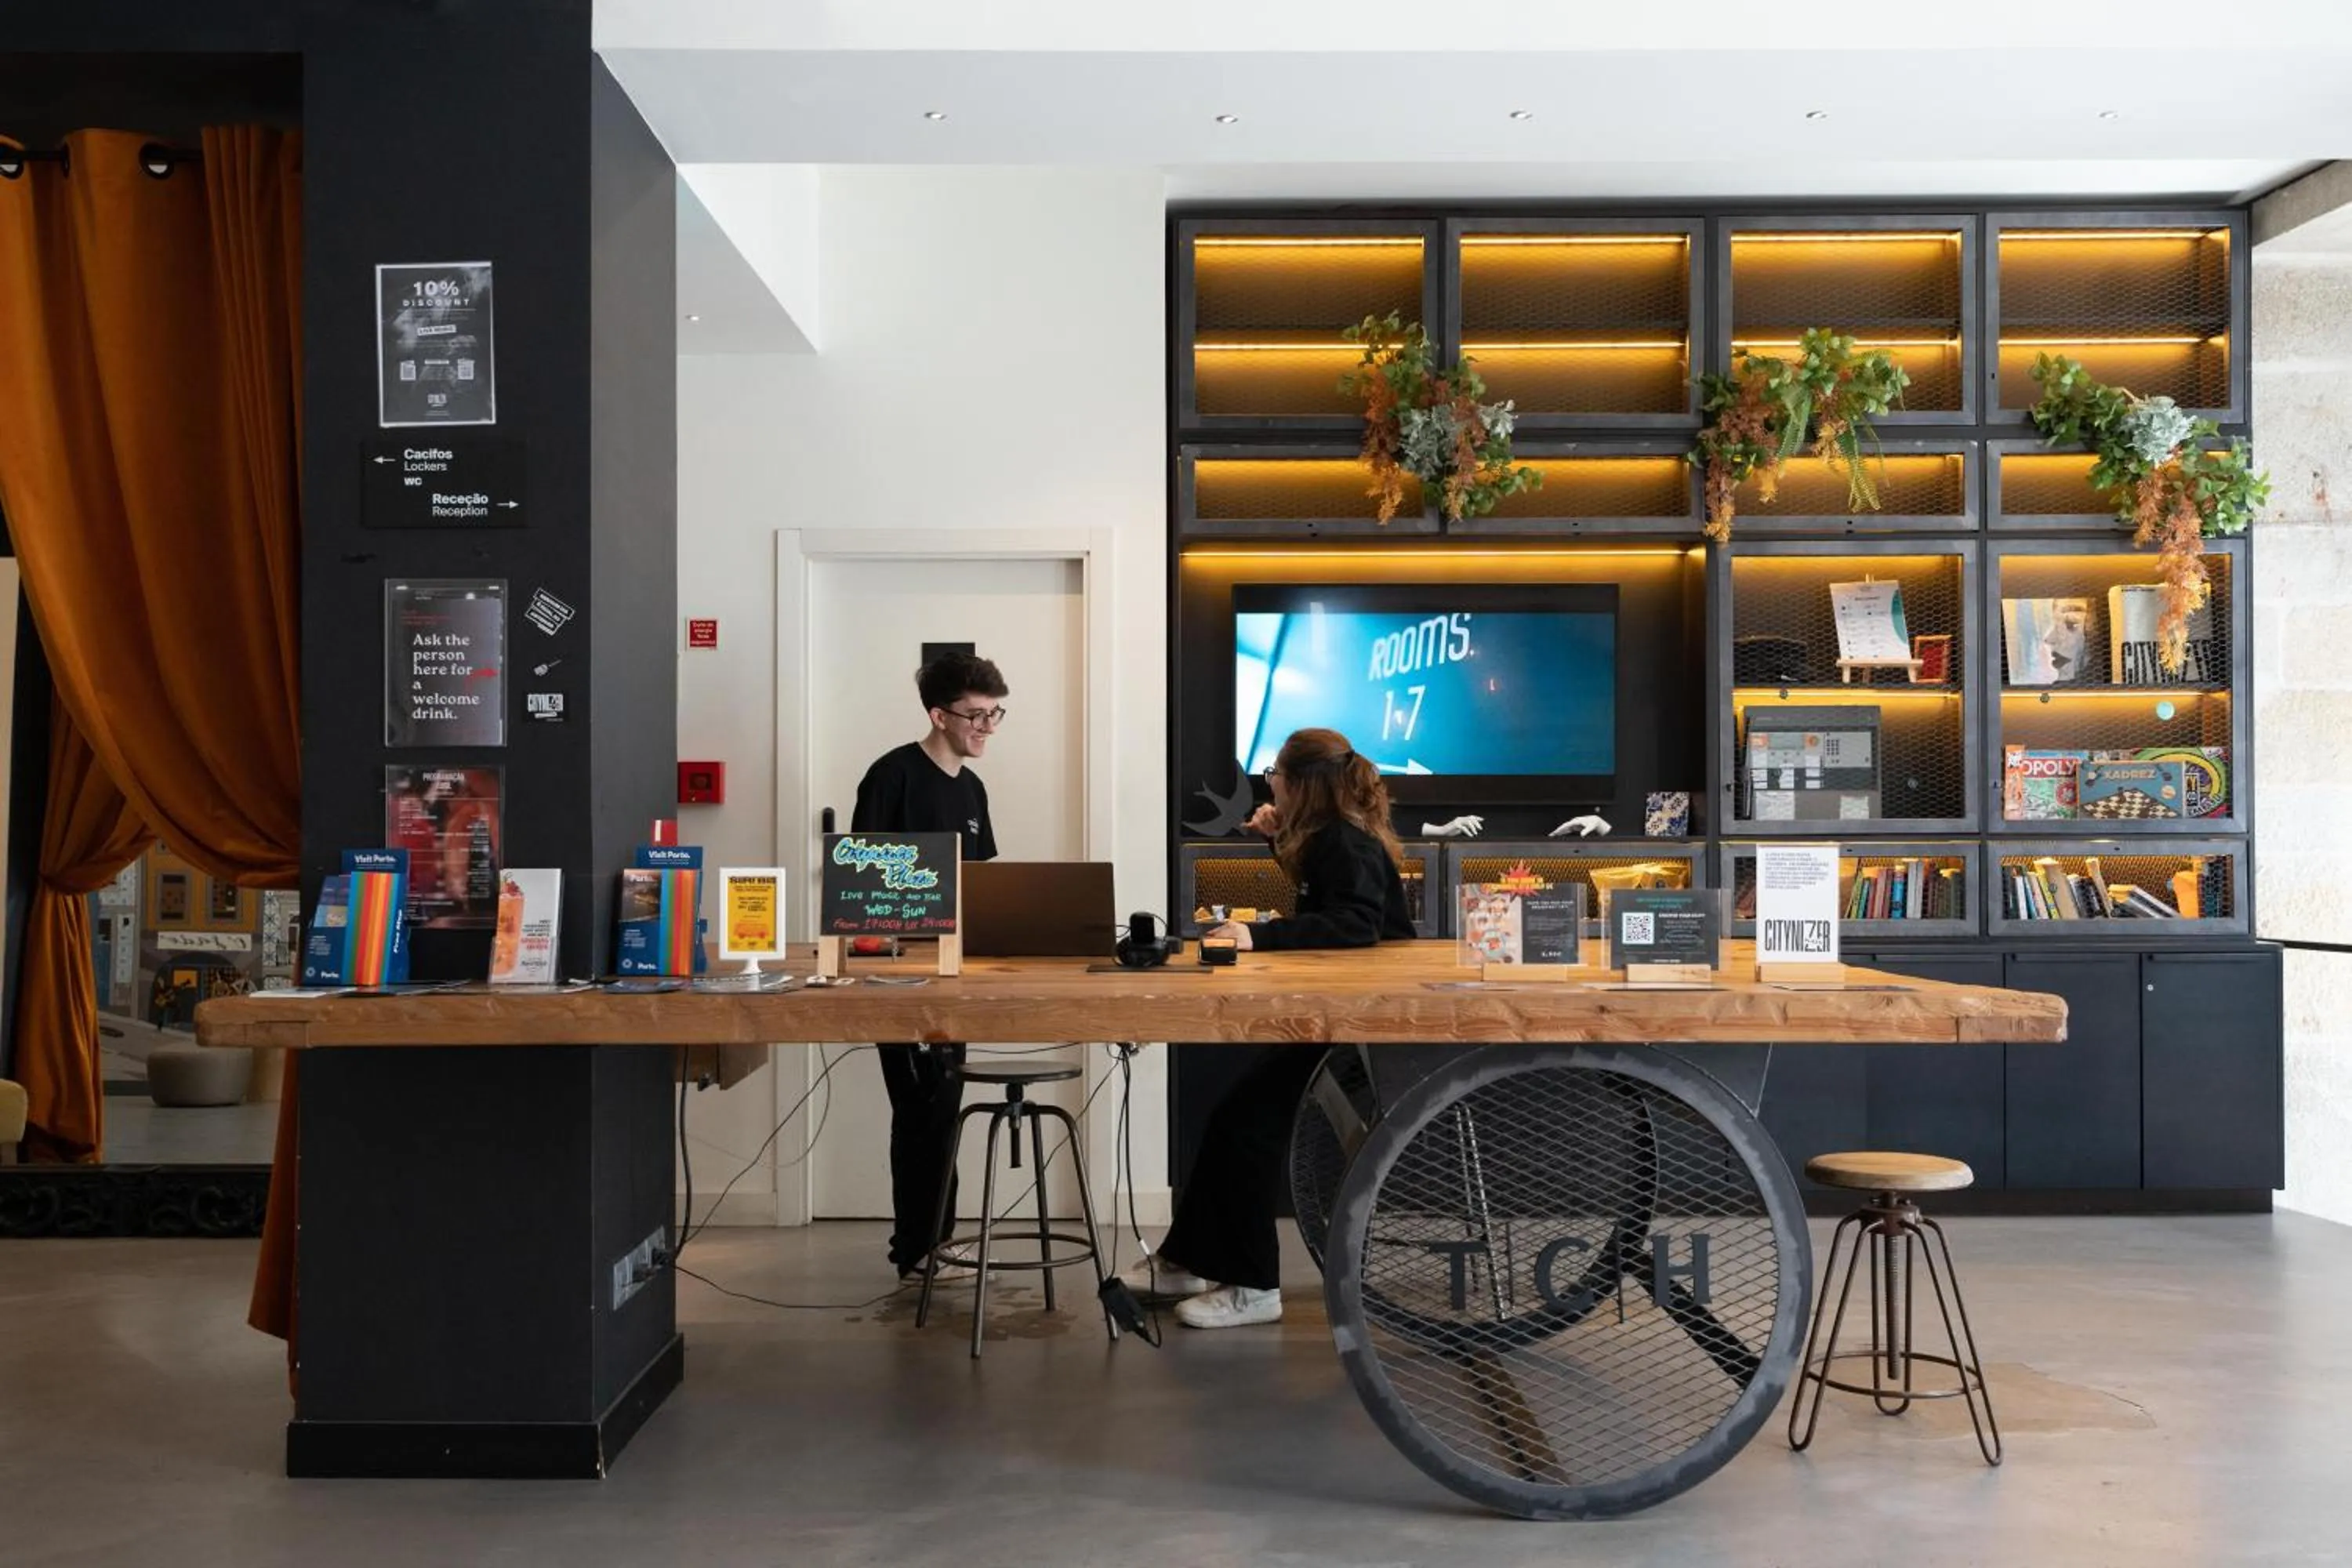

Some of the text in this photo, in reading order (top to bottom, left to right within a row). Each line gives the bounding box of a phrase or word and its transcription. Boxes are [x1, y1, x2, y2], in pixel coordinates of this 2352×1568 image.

[413, 280, 459, 296] 10%
[404, 448, 453, 460] Cacifos
[404, 461, 448, 471] Lockers
[432, 493, 489, 506] Receção
[432, 506, 488, 517] Reception
[413, 633, 470, 646] Ask the
[413, 651, 465, 665] person
[413, 663, 474, 676] here for
[412, 681, 423, 691] a
[412, 692, 481, 706] welcome
[412, 707, 458, 720] drink.
[2103, 770, 2155, 780] XADREZ
[354, 854, 372, 863] Visit
[648, 850, 666, 858] Visit
[1765, 920, 1831, 952] CITYNIZER
